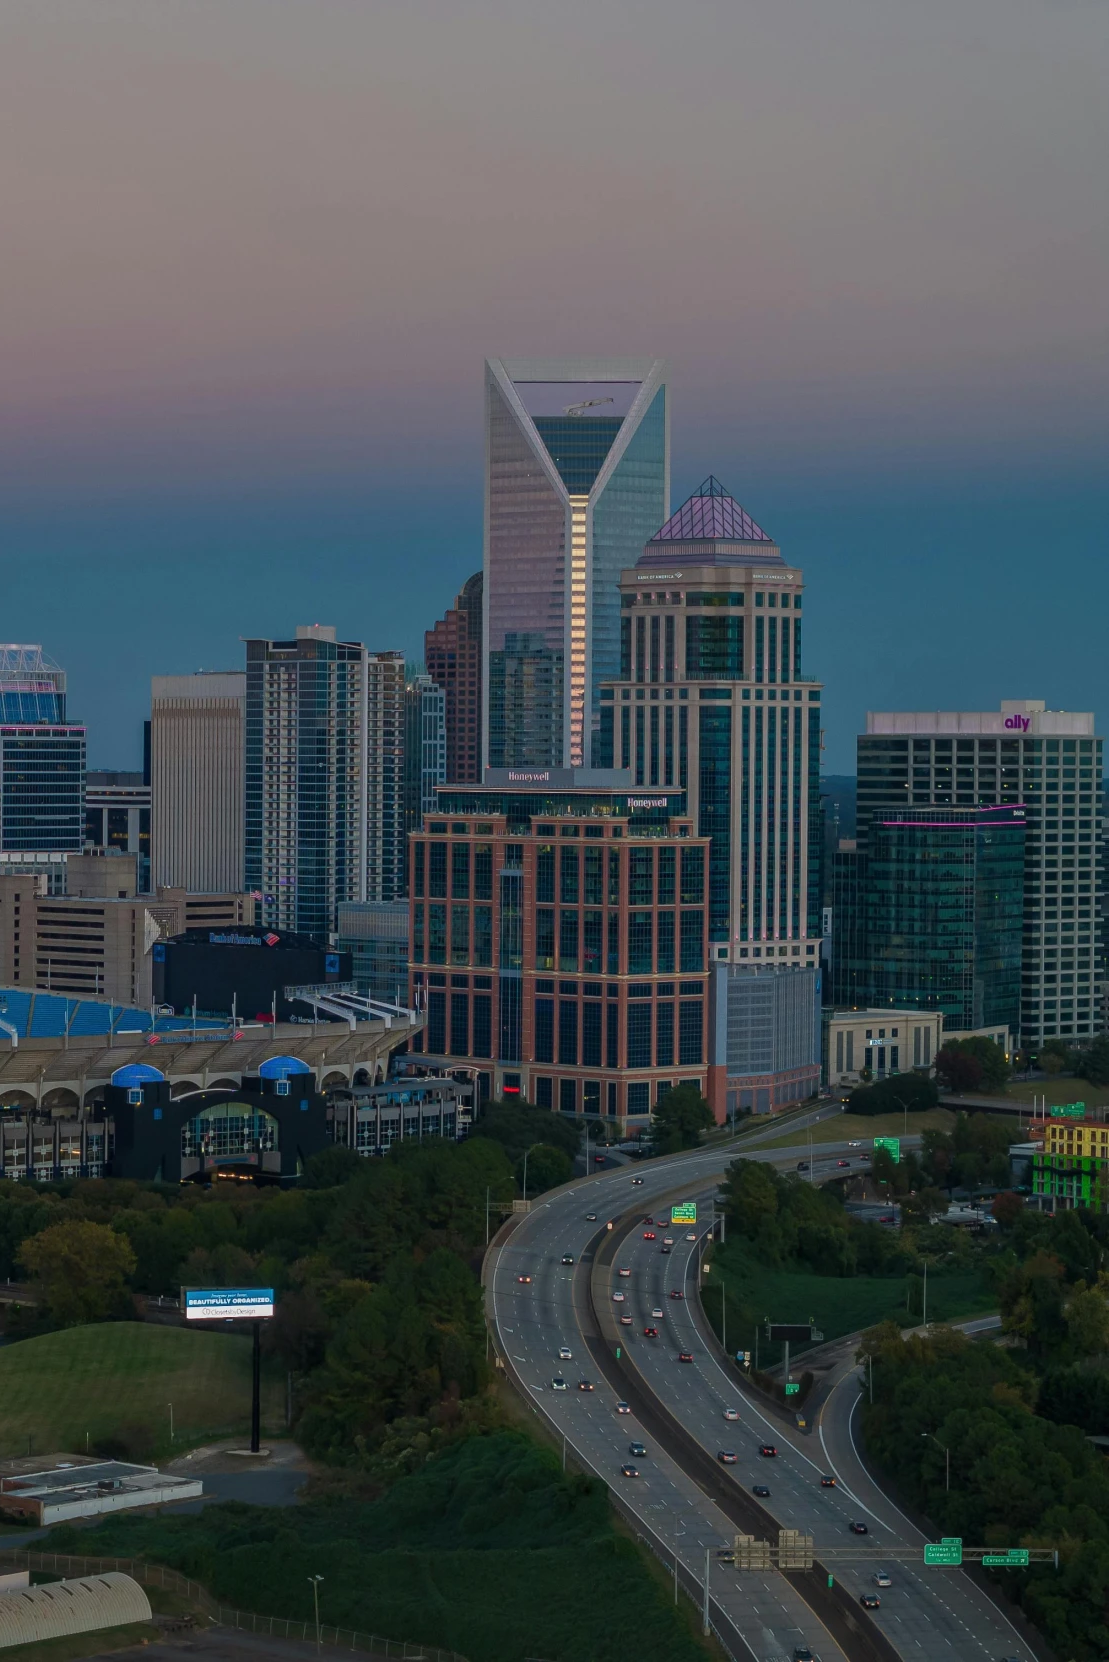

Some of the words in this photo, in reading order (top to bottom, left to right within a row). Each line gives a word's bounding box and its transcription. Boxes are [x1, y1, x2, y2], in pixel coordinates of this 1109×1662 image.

[1005, 715, 1030, 733] ally
[509, 772, 549, 783] Honeywell
[628, 798, 667, 810] Honeywell
